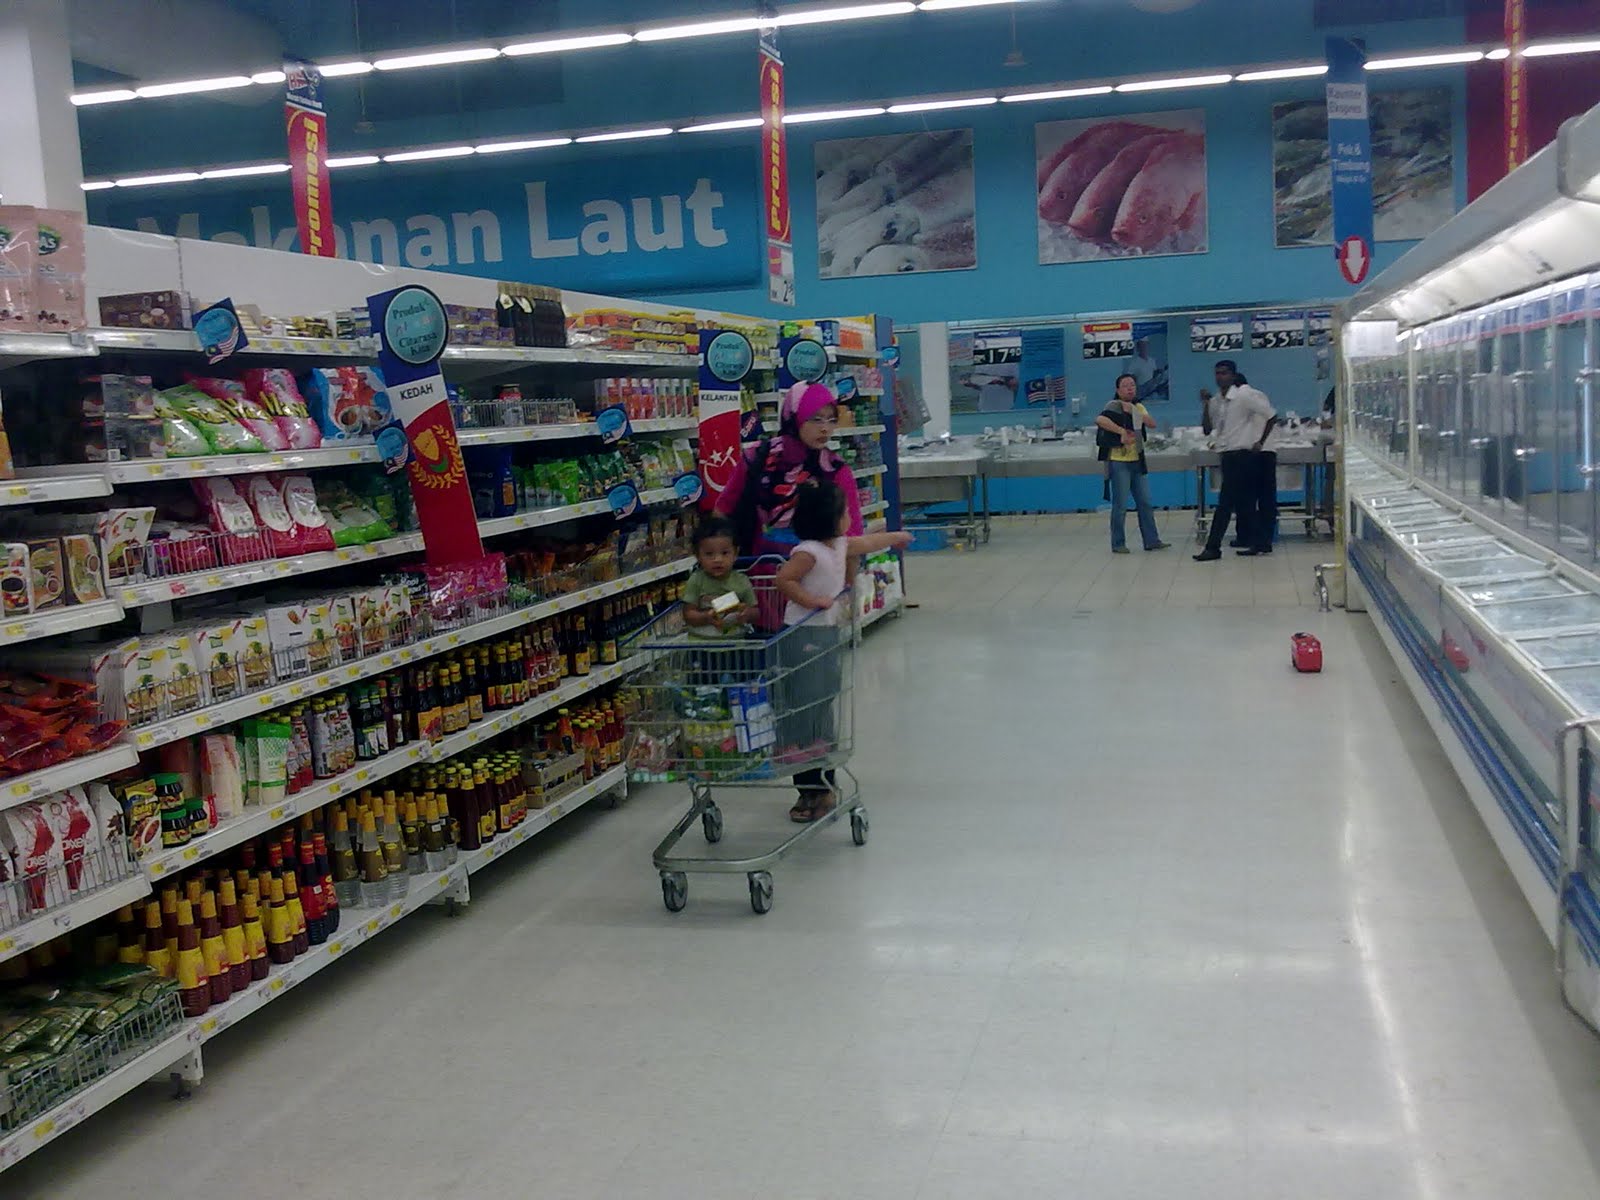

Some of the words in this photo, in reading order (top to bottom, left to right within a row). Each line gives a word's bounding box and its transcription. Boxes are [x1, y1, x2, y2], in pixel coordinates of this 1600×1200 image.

[525, 178, 729, 259] Laut
[400, 383, 434, 401] KEDAH
[701, 393, 739, 402] KELANTAN
